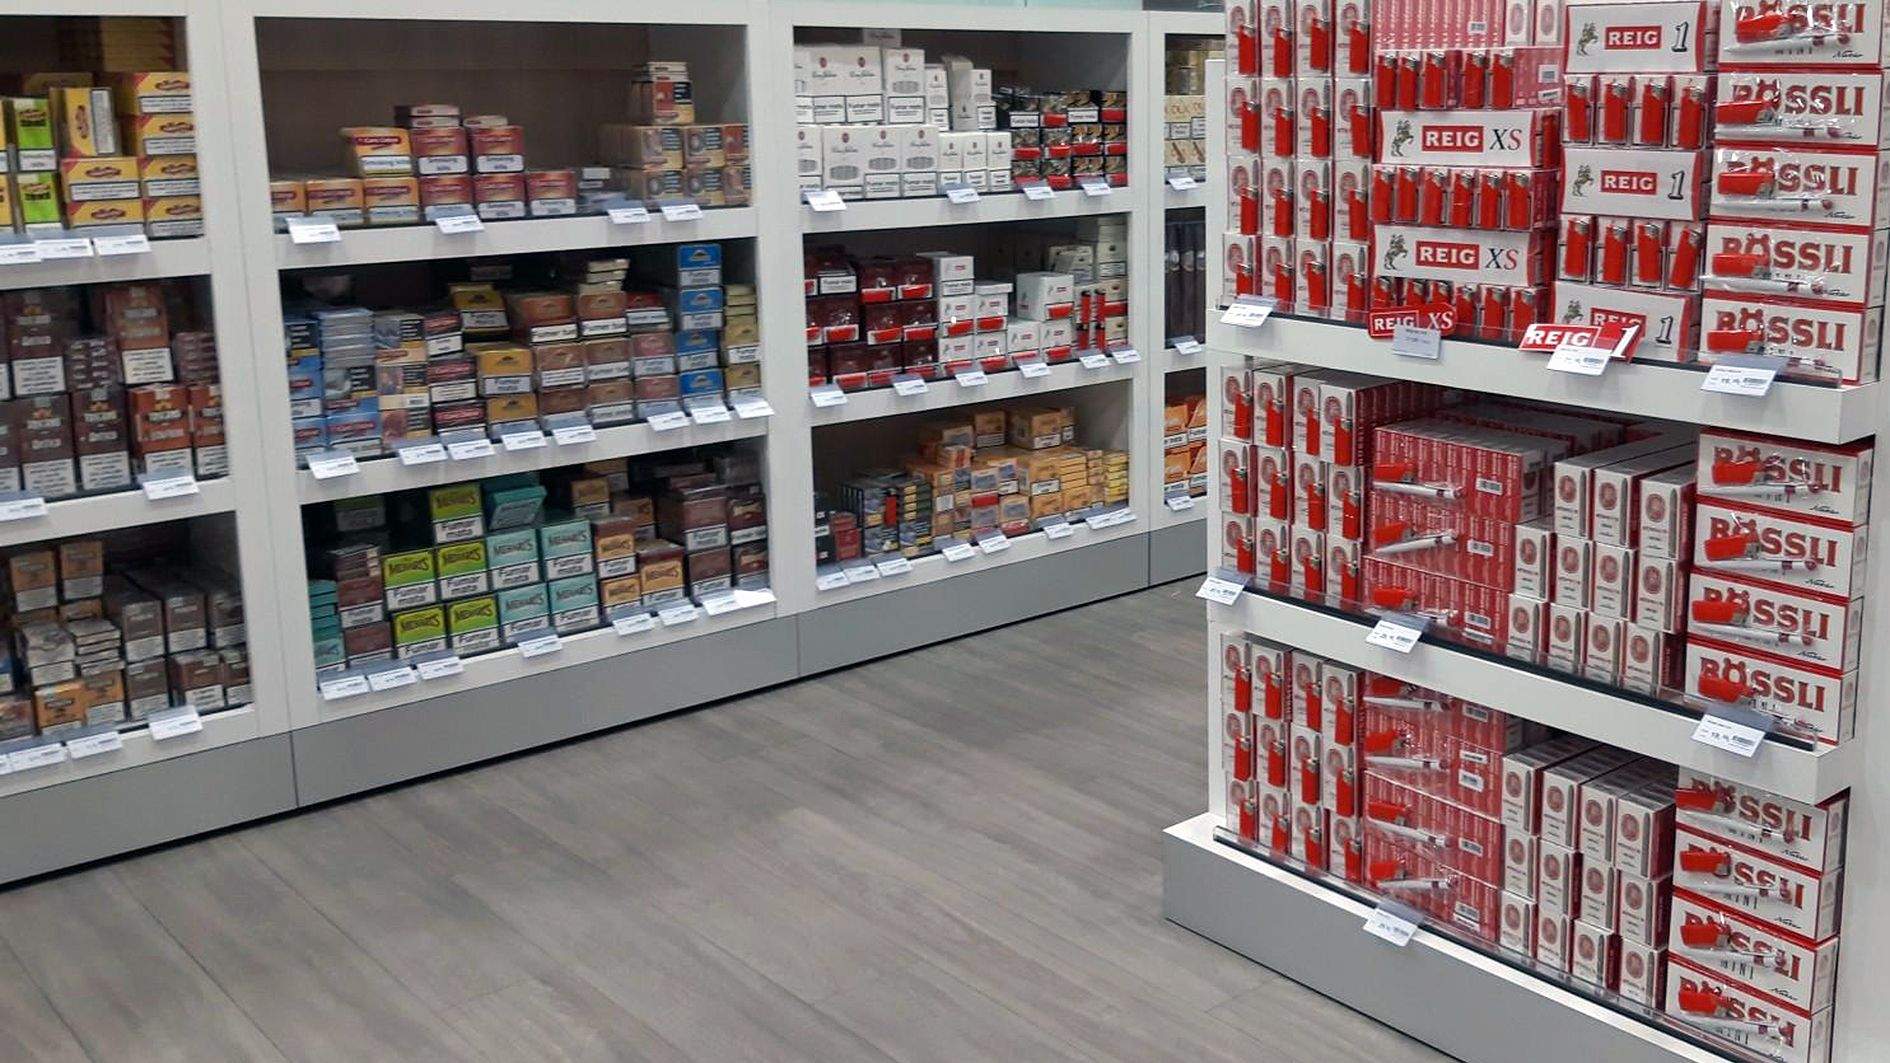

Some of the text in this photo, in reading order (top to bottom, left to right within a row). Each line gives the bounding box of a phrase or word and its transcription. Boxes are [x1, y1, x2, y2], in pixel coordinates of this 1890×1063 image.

[1608, 21, 1689, 52] REIG 1
[1425, 128, 1523, 151] REIG XS
[1603, 170, 1686, 200] REIG 1
[1726, 156, 1860, 196] SSLI
[1419, 246, 1519, 270] REIG XS
[1721, 232, 1853, 274] RÖSSLI
[1374, 311, 1454, 331] REIG XS
[1594, 312, 1674, 344] REIG 1
[1716, 307, 1847, 352] RÖSSLI
[1526, 325, 1640, 358] REIG 1
[498, 566, 533, 577] Fumar
[553, 556, 589, 568] Fumar
[392, 586, 430, 598] Fumar
[1699, 657, 1826, 713] RÖSSLI
[1687, 843, 1805, 910] SSLI
[1679, 976, 1797, 1049] RSSI
